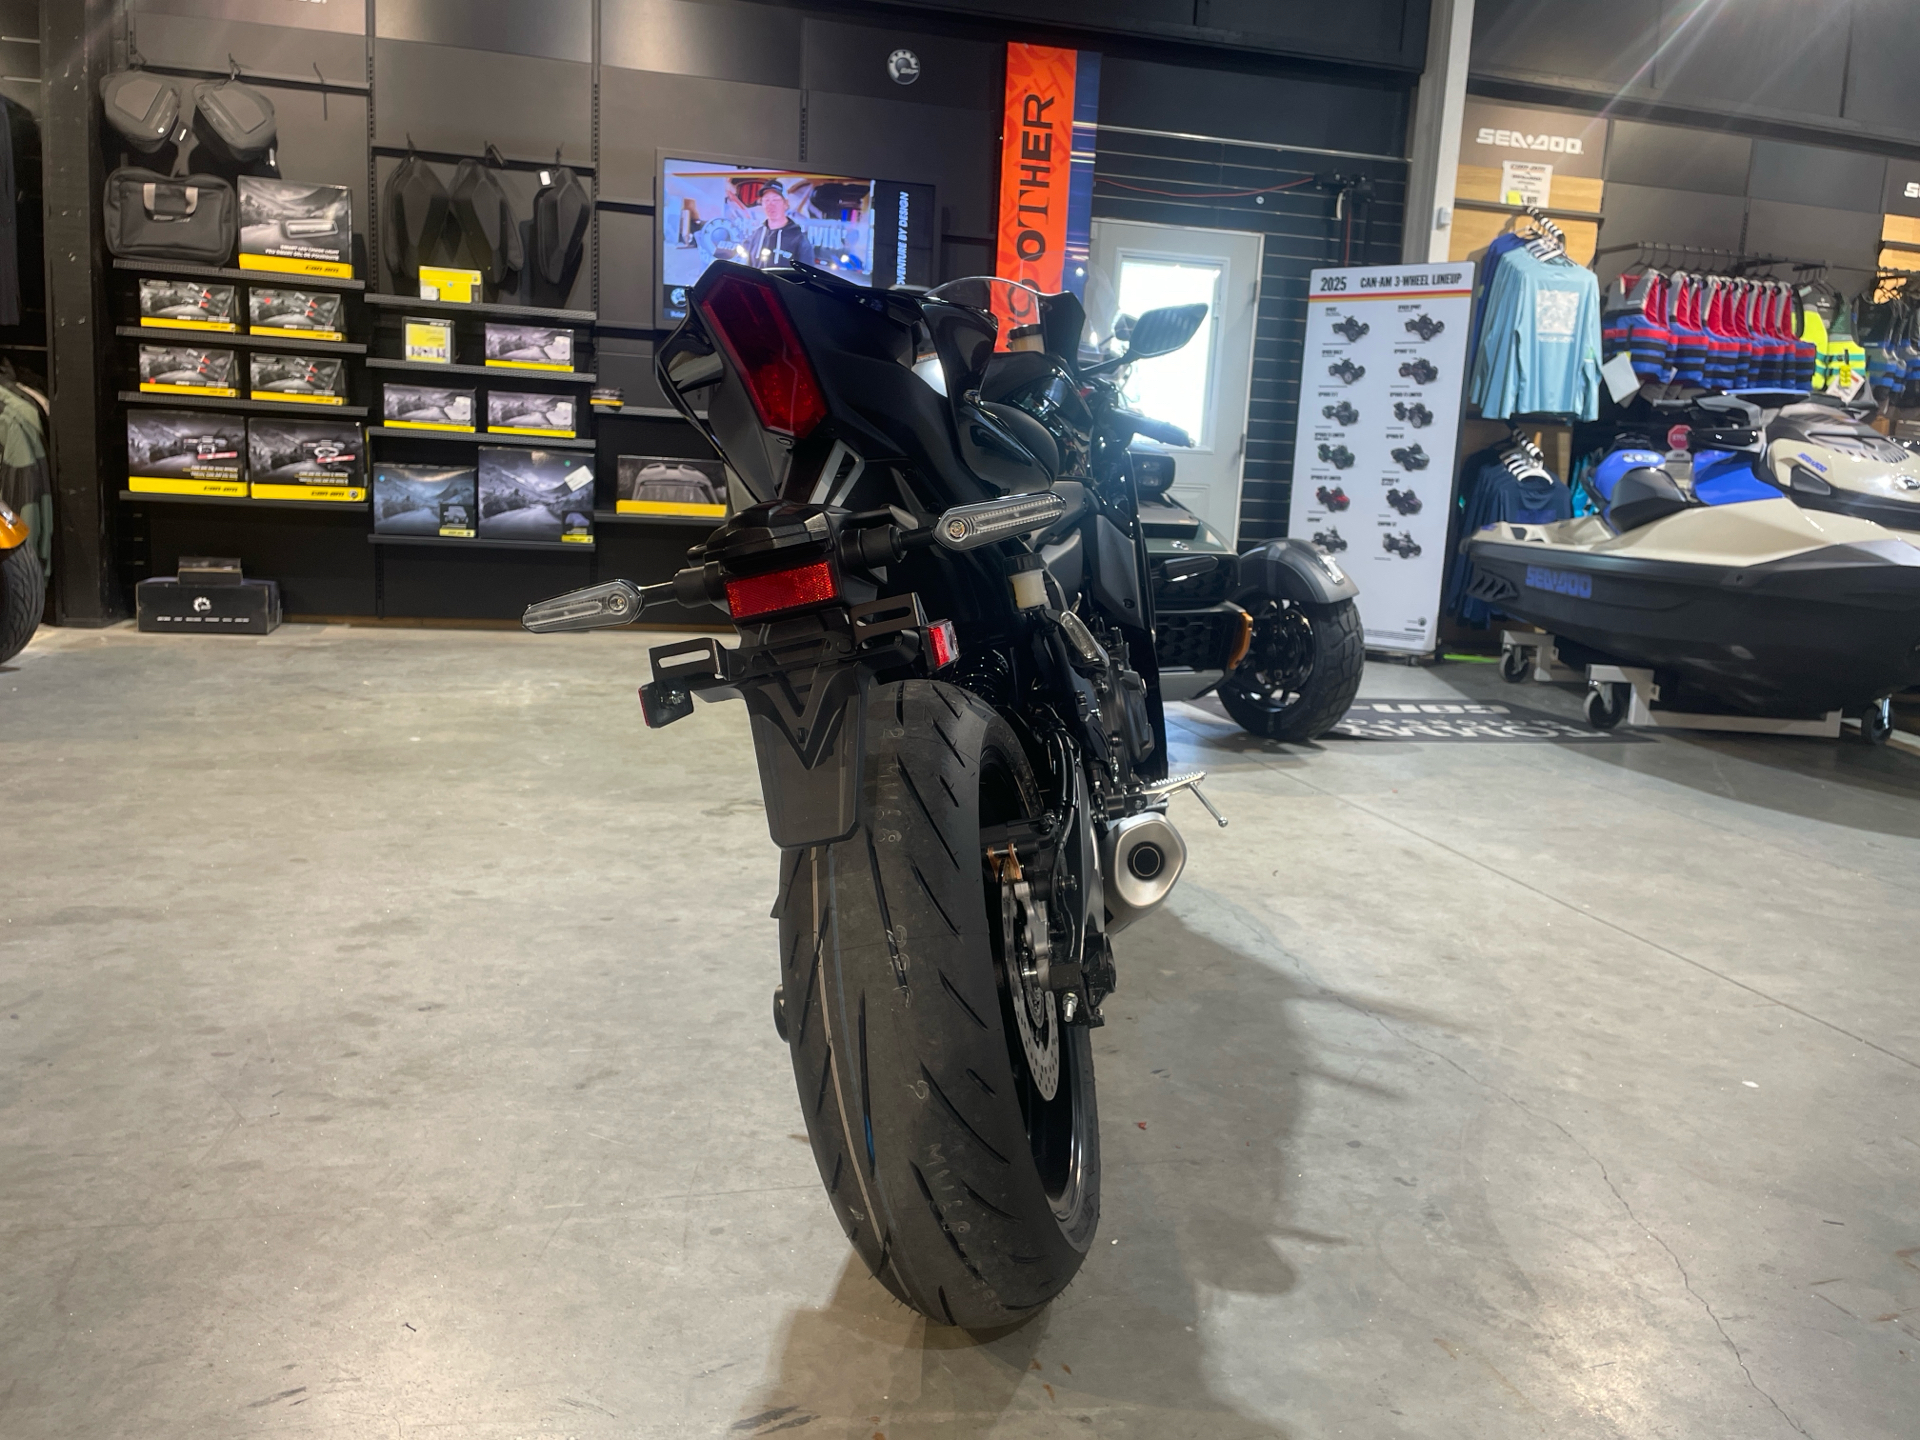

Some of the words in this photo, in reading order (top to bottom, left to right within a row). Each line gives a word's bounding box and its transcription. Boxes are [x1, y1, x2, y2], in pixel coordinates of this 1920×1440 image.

[1016, 93, 1055, 262] OTHER
[899, 191, 910, 228] DESIGN
[898, 228, 908, 241] BY
[1320, 276, 1347, 292] 2025
[1360, 276, 1392, 288] CAN-AM
[1394, 275, 1429, 287] 3-WHEEL
[1432, 273, 1462, 286] LINEUP
